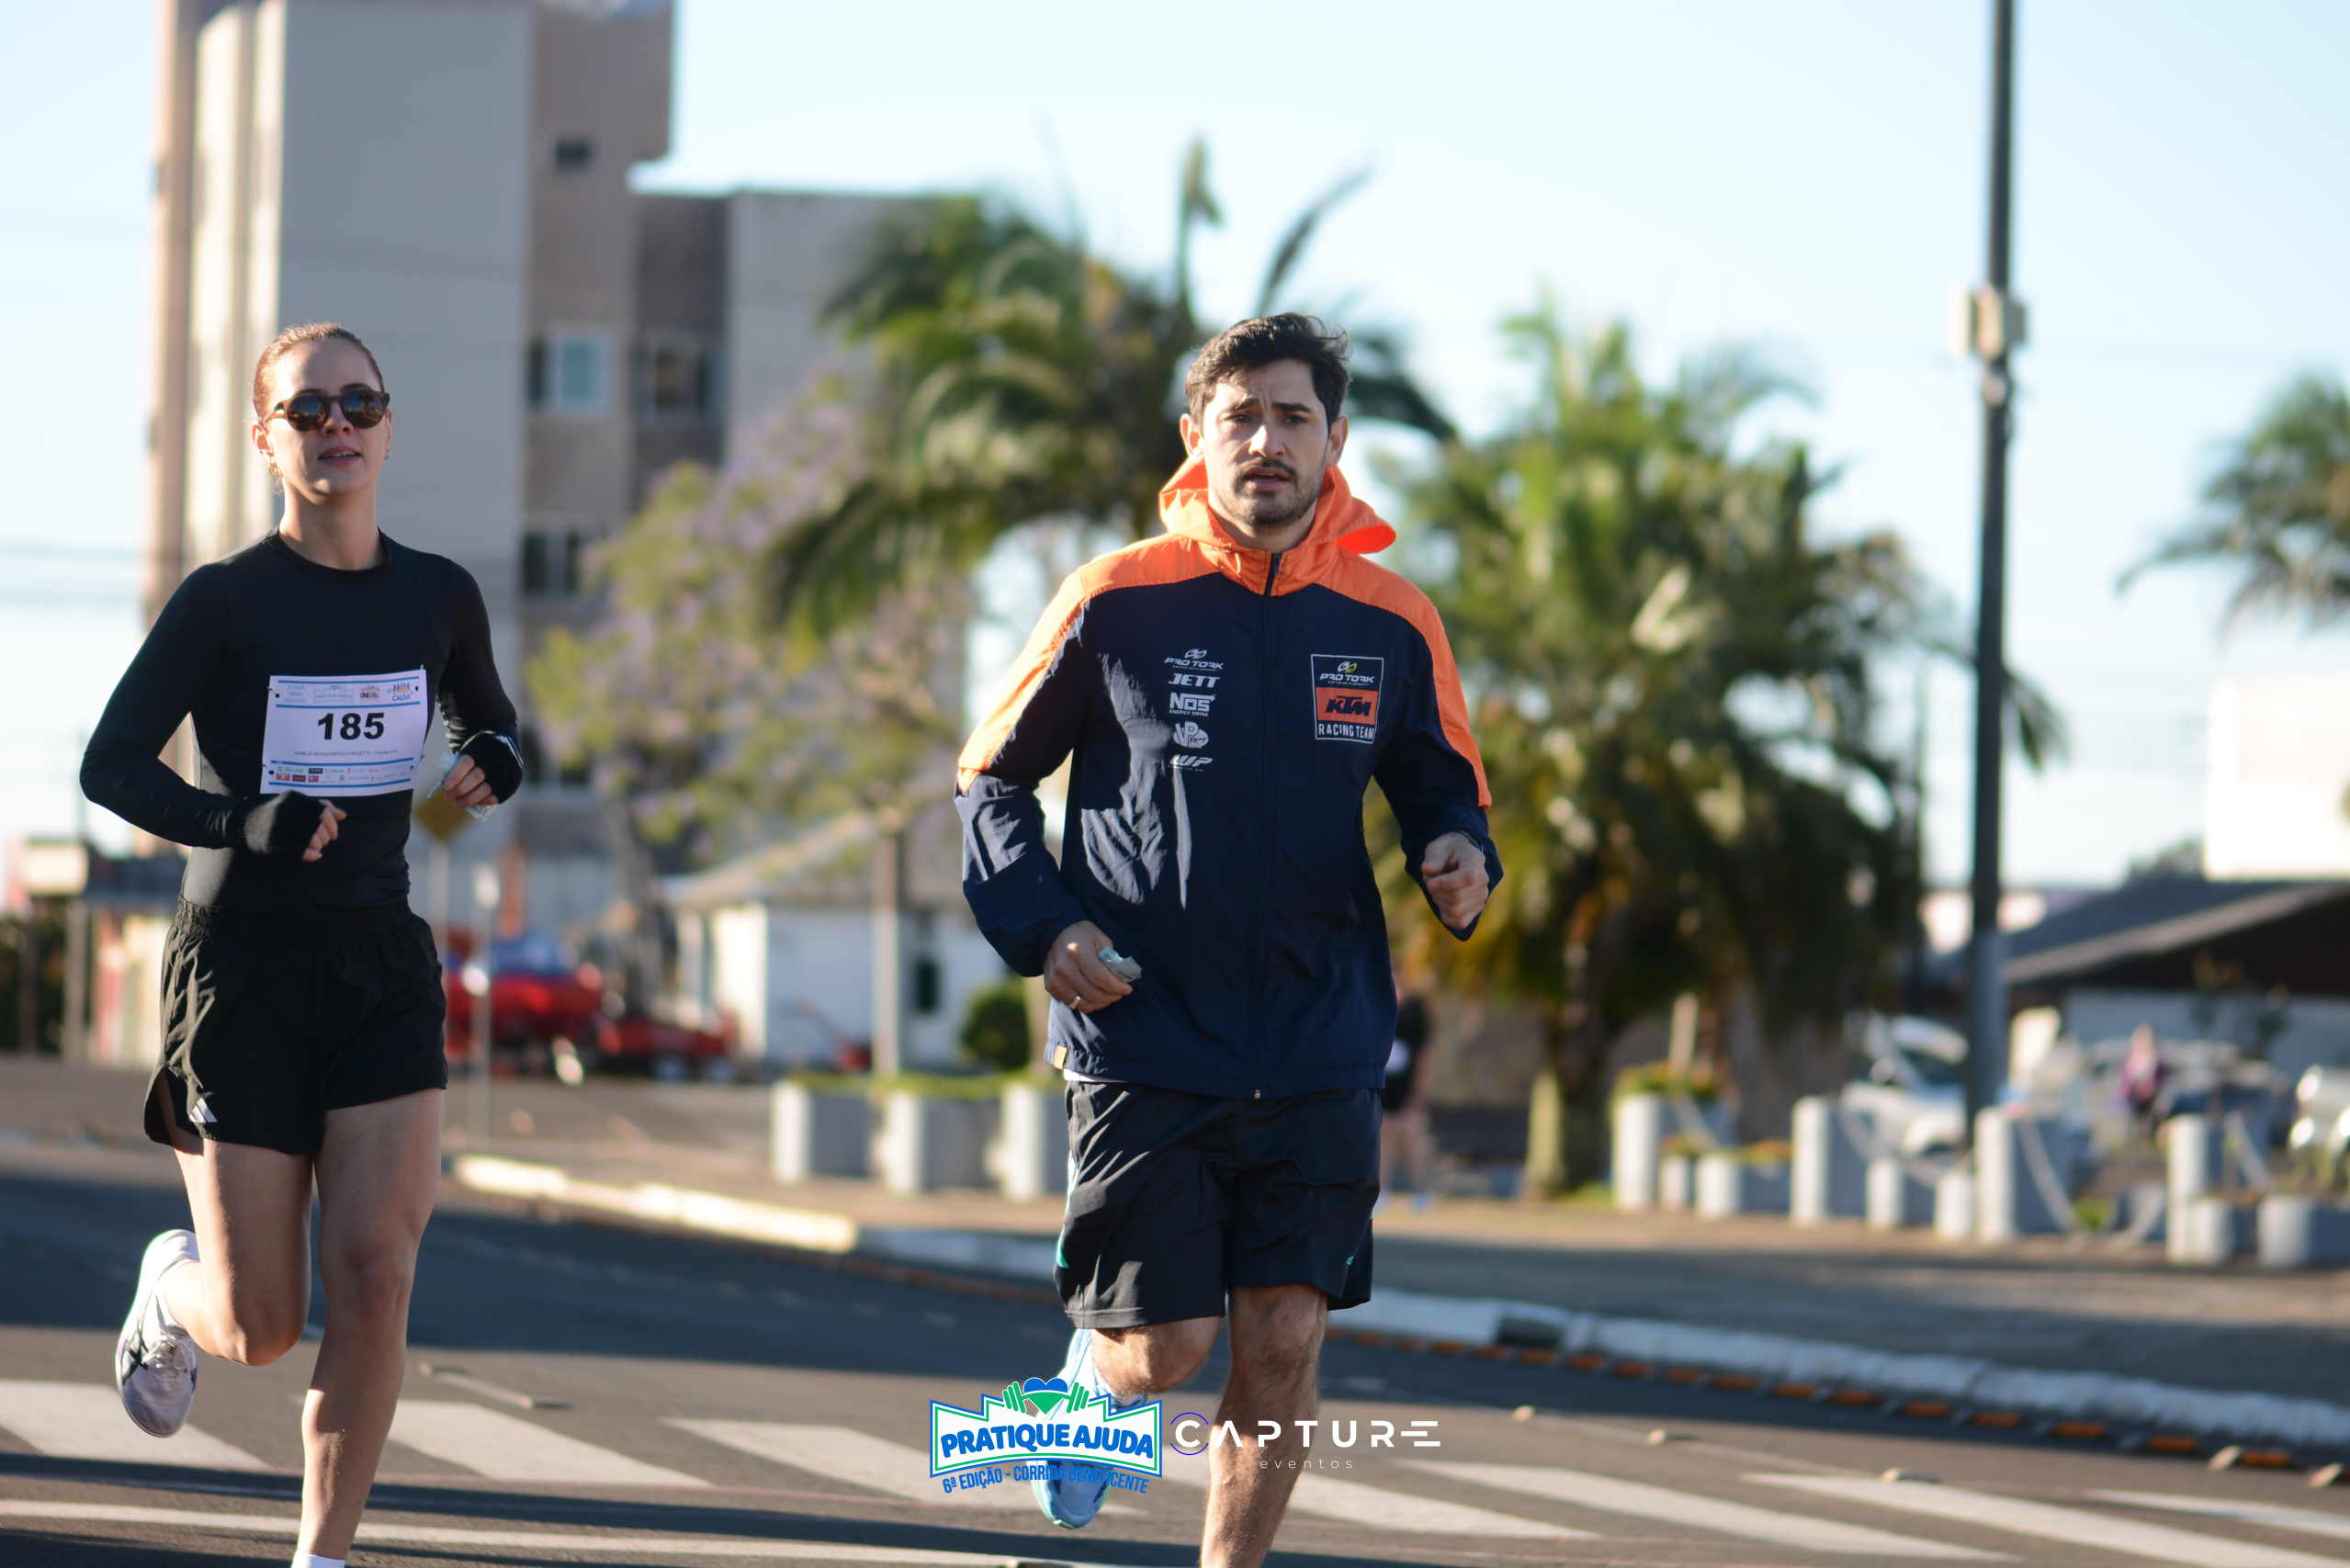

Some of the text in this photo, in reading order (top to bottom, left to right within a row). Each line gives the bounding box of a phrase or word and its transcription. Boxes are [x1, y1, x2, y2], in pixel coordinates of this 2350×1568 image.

[1164, 657, 1225, 670] PRO TORK
[1168, 672, 1220, 688] JETT
[1319, 672, 1343, 681] PRO
[1344, 674, 1375, 683] TORK
[391, 694, 411, 702] CAUSA
[1169, 692, 1215, 712] NOS
[1325, 695, 1373, 716] KTM
[317, 712, 385, 740] 185
[1318, 723, 1375, 739] RACING TEAM
[1169, 753, 1214, 767] WP
